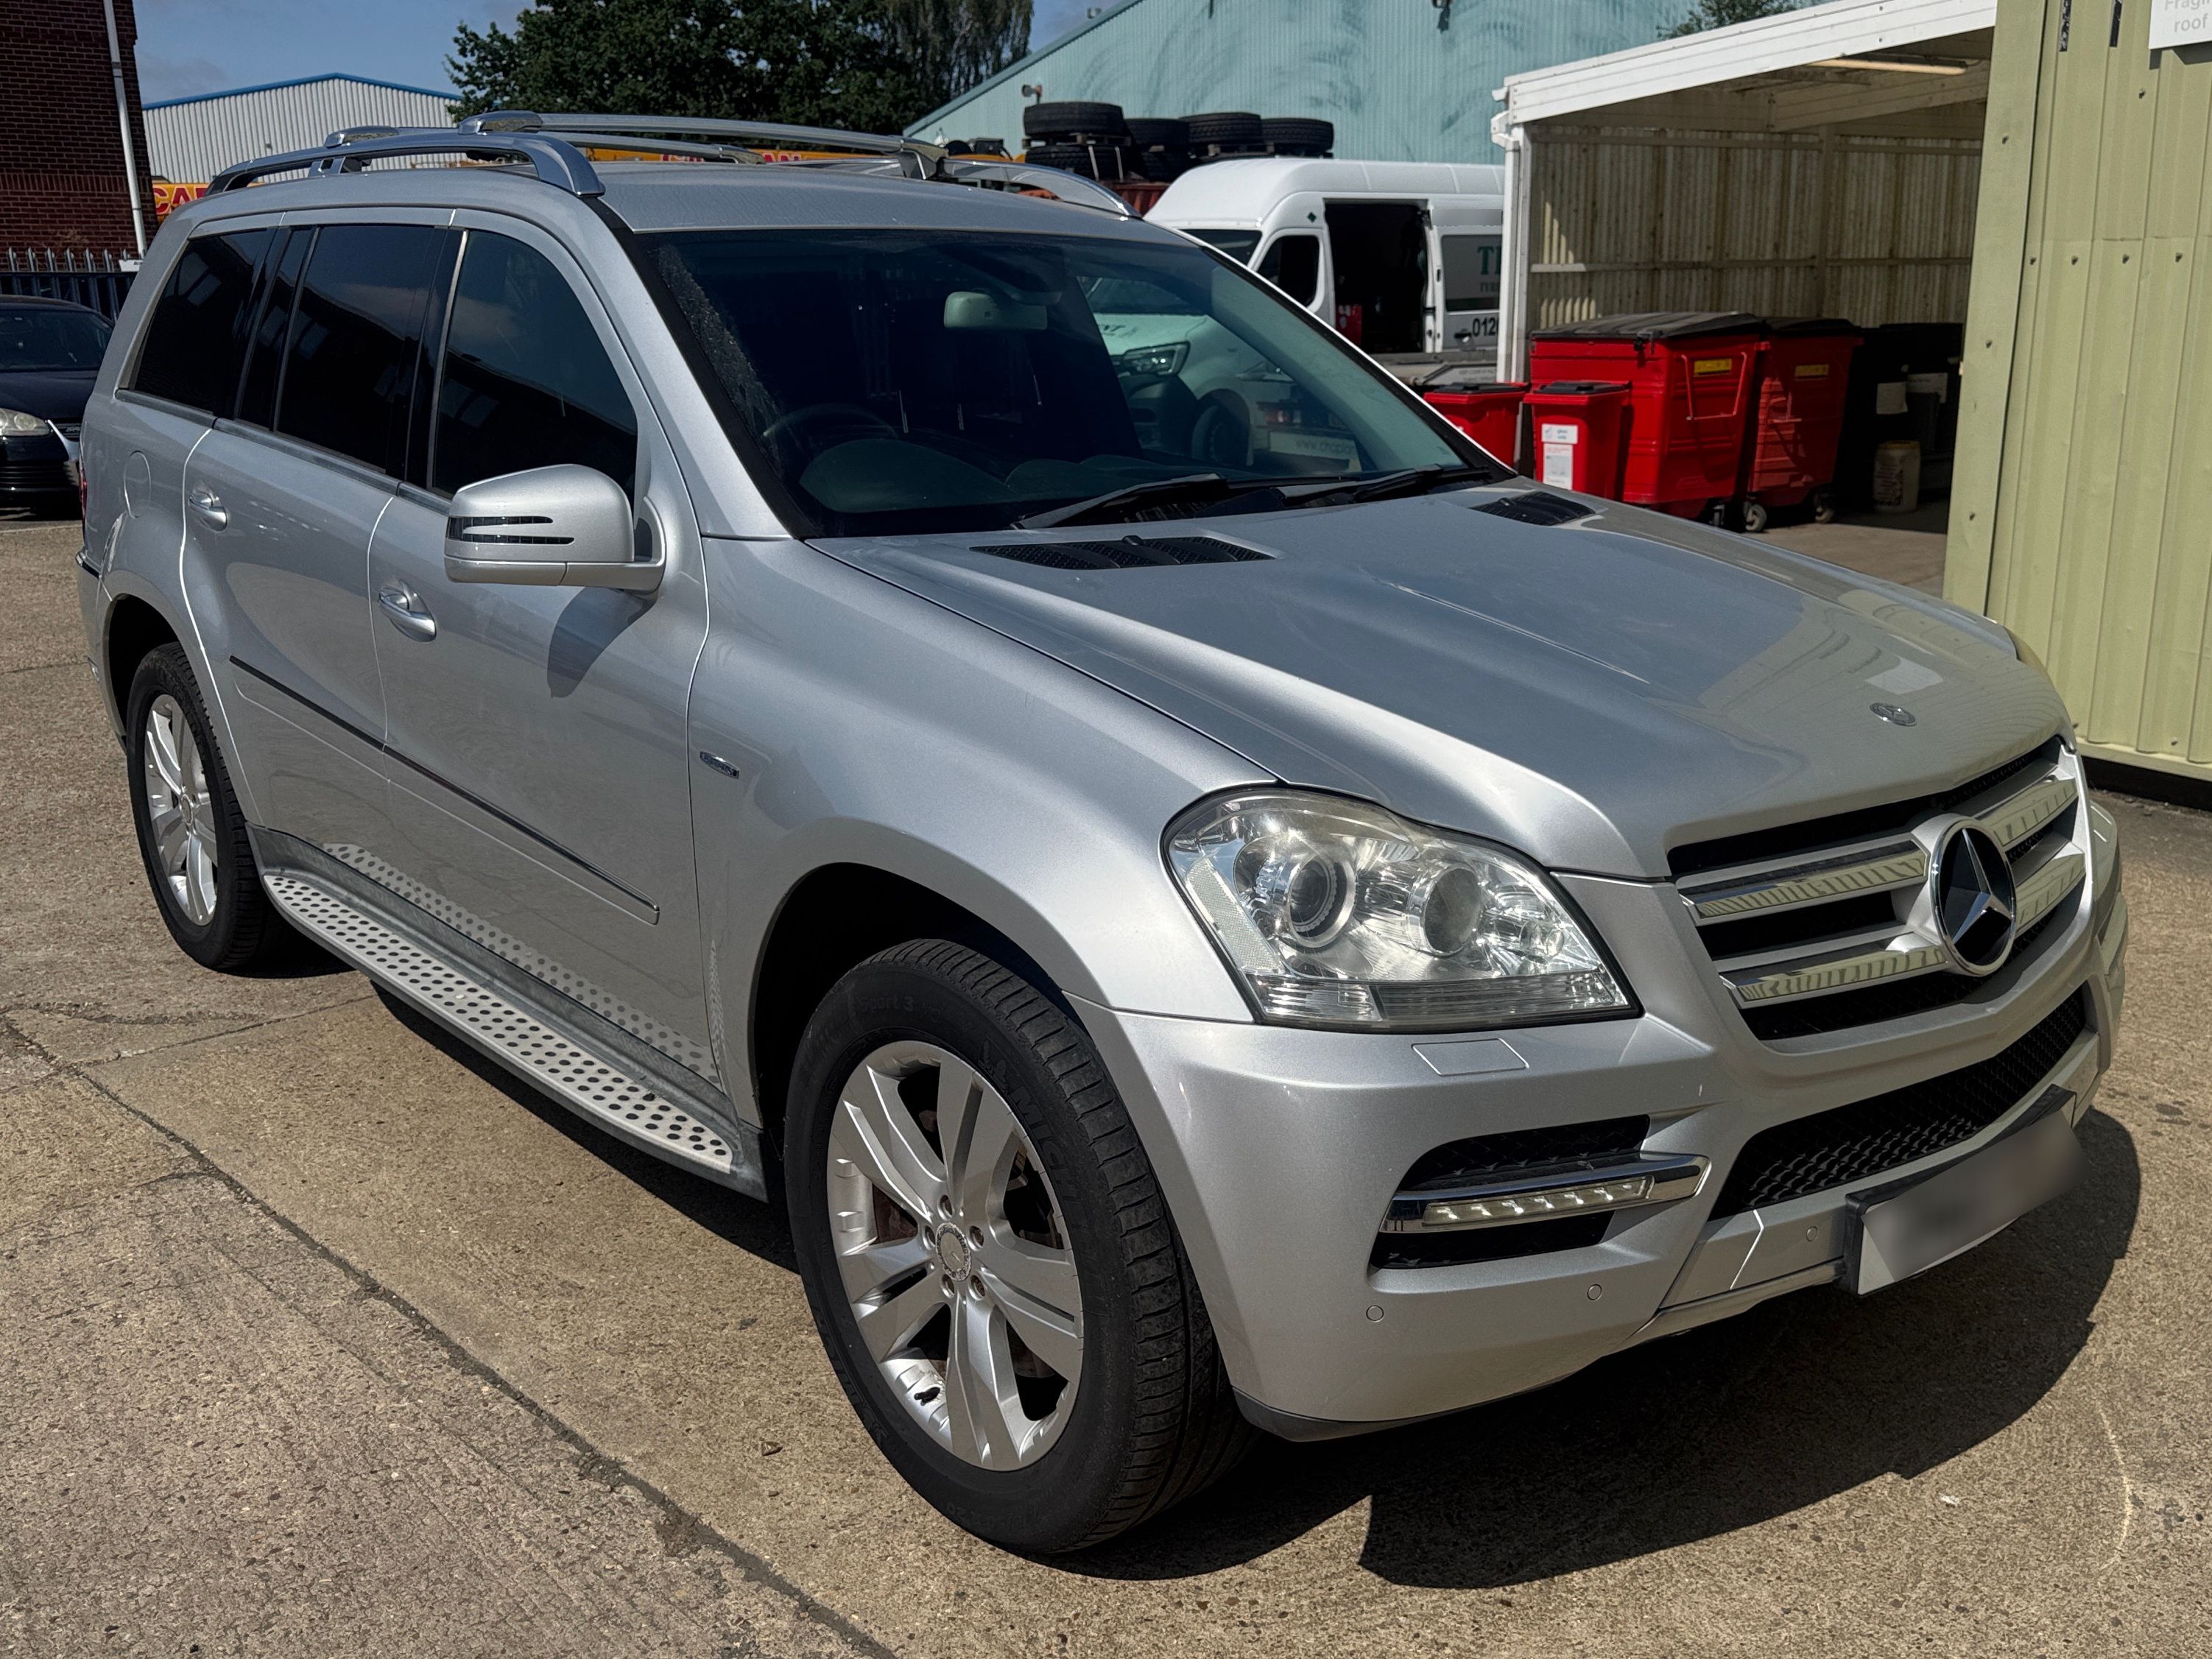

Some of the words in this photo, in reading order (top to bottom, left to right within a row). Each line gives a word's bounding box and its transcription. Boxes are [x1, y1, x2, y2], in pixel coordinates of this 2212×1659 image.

[2164, 0, 2210, 11] Frag
[2174, 12, 2208, 32] roof
[1473, 316, 1499, 337] 012
